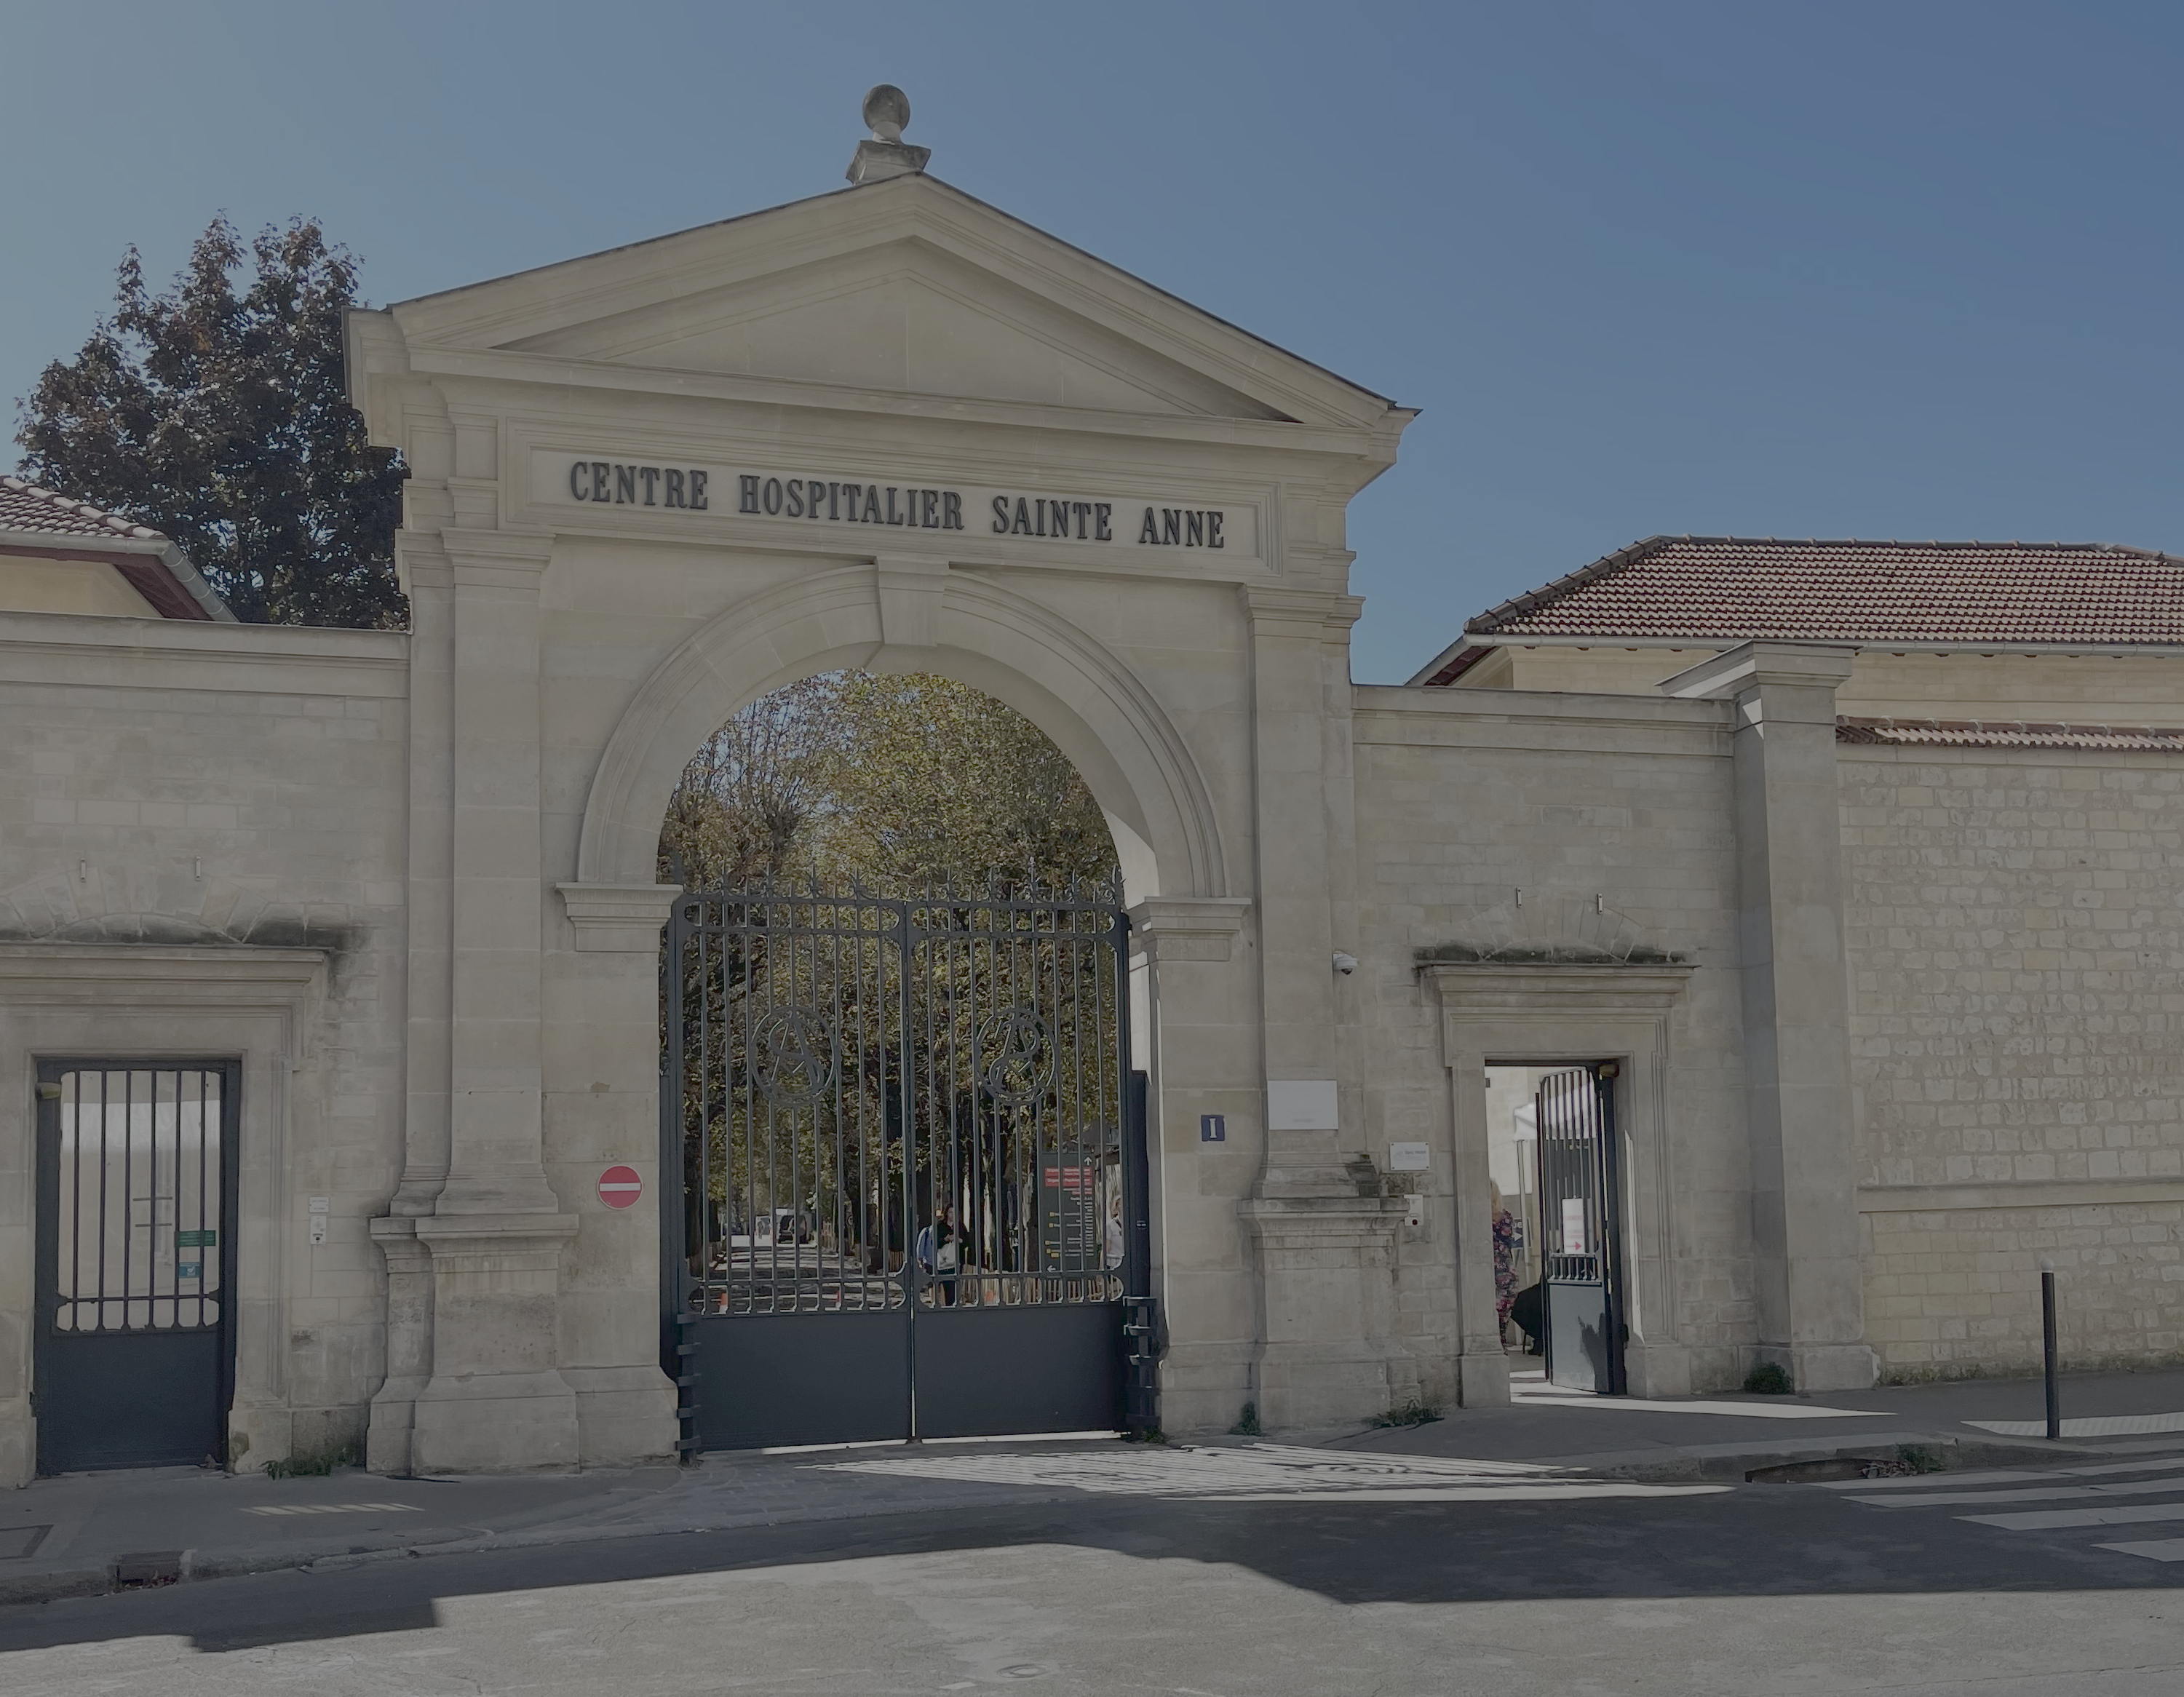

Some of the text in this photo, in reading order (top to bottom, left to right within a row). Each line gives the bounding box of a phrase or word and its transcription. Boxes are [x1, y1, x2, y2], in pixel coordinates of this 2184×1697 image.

[571, 461, 1224, 548] CENTRE HOSPITALIER SAINTE ANNE
[1209, 1118, 1218, 1139] 1
